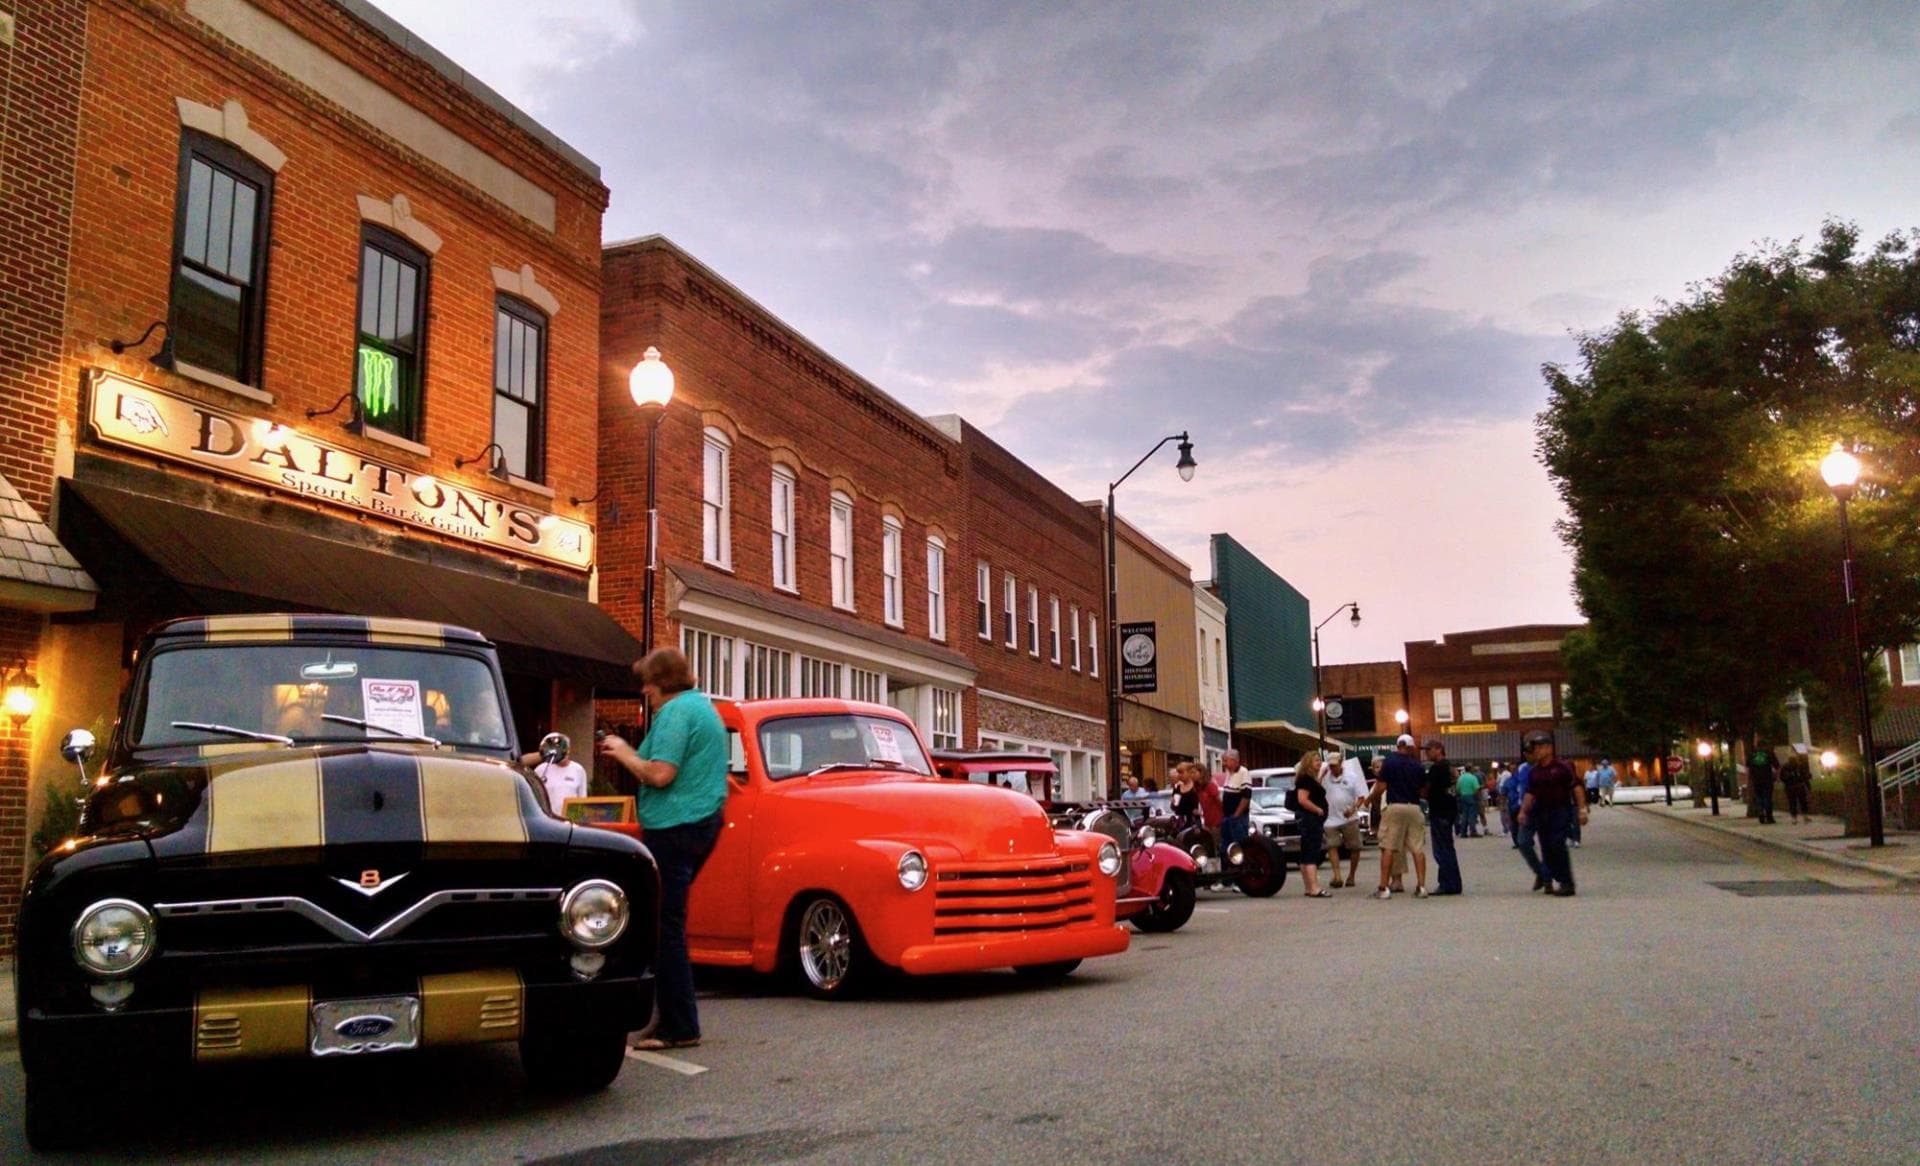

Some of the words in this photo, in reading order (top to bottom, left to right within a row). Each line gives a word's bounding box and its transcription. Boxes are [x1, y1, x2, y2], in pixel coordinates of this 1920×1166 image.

[190, 408, 540, 545] DALTON'S
[281, 472, 361, 506] Sports
[371, 498, 408, 519] Bar
[430, 515, 485, 539] Grille
[349, 1022, 381, 1034] Ford
